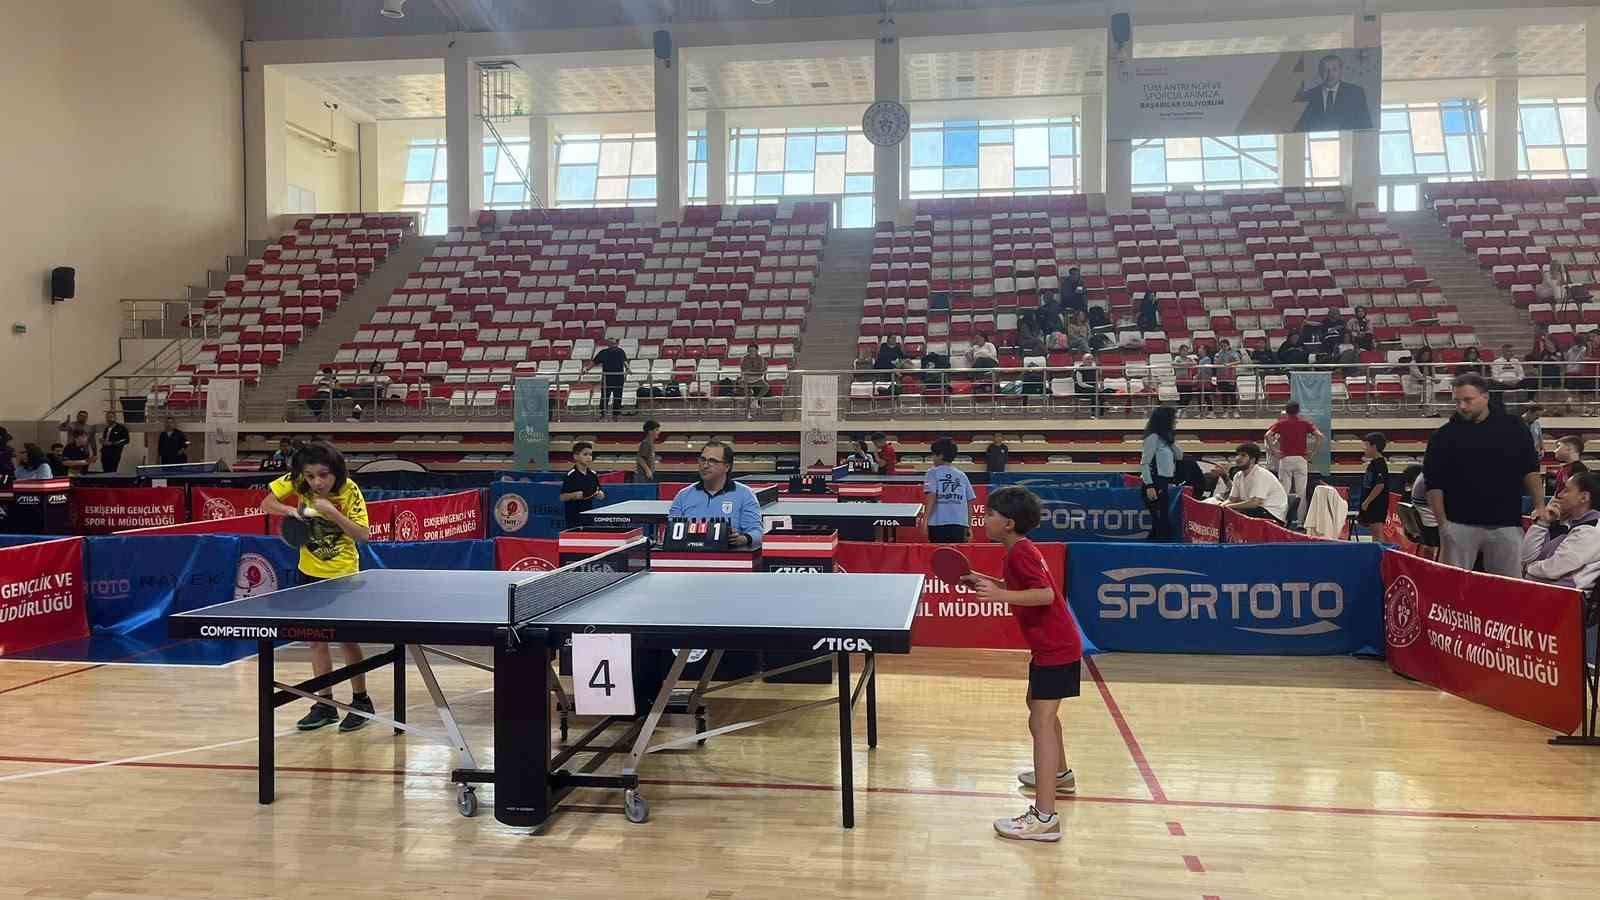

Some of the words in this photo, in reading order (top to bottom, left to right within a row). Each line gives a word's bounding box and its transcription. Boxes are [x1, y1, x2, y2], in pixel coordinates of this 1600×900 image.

[127, 504, 161, 516] GENÇLİK
[162, 504, 175, 513] VE
[1038, 508, 1152, 529] PORTOTO
[84, 517, 105, 526] SPOR
[108, 516, 115, 526] İL
[672, 522, 685, 540] 0
[714, 522, 721, 540] 1
[1, 572, 53, 600] GENÇLİK
[54, 571, 73, 588] VE
[1097, 582, 1344, 620] SPORTOTO
[200, 625, 278, 638] COMPETITION
[1427, 603, 1481, 634] ESKİŞEHİR
[1484, 619, 1533, 649] GENÇLİK
[1538, 633, 1559, 655] VE
[812, 637, 873, 652] STIGA
[1427, 628, 1452, 651] SPOR
[1453, 634, 1463, 657] İL
[1466, 642, 1559, 687] MÜDÜRLÜĞÜ
[588, 659, 616, 697] 4
